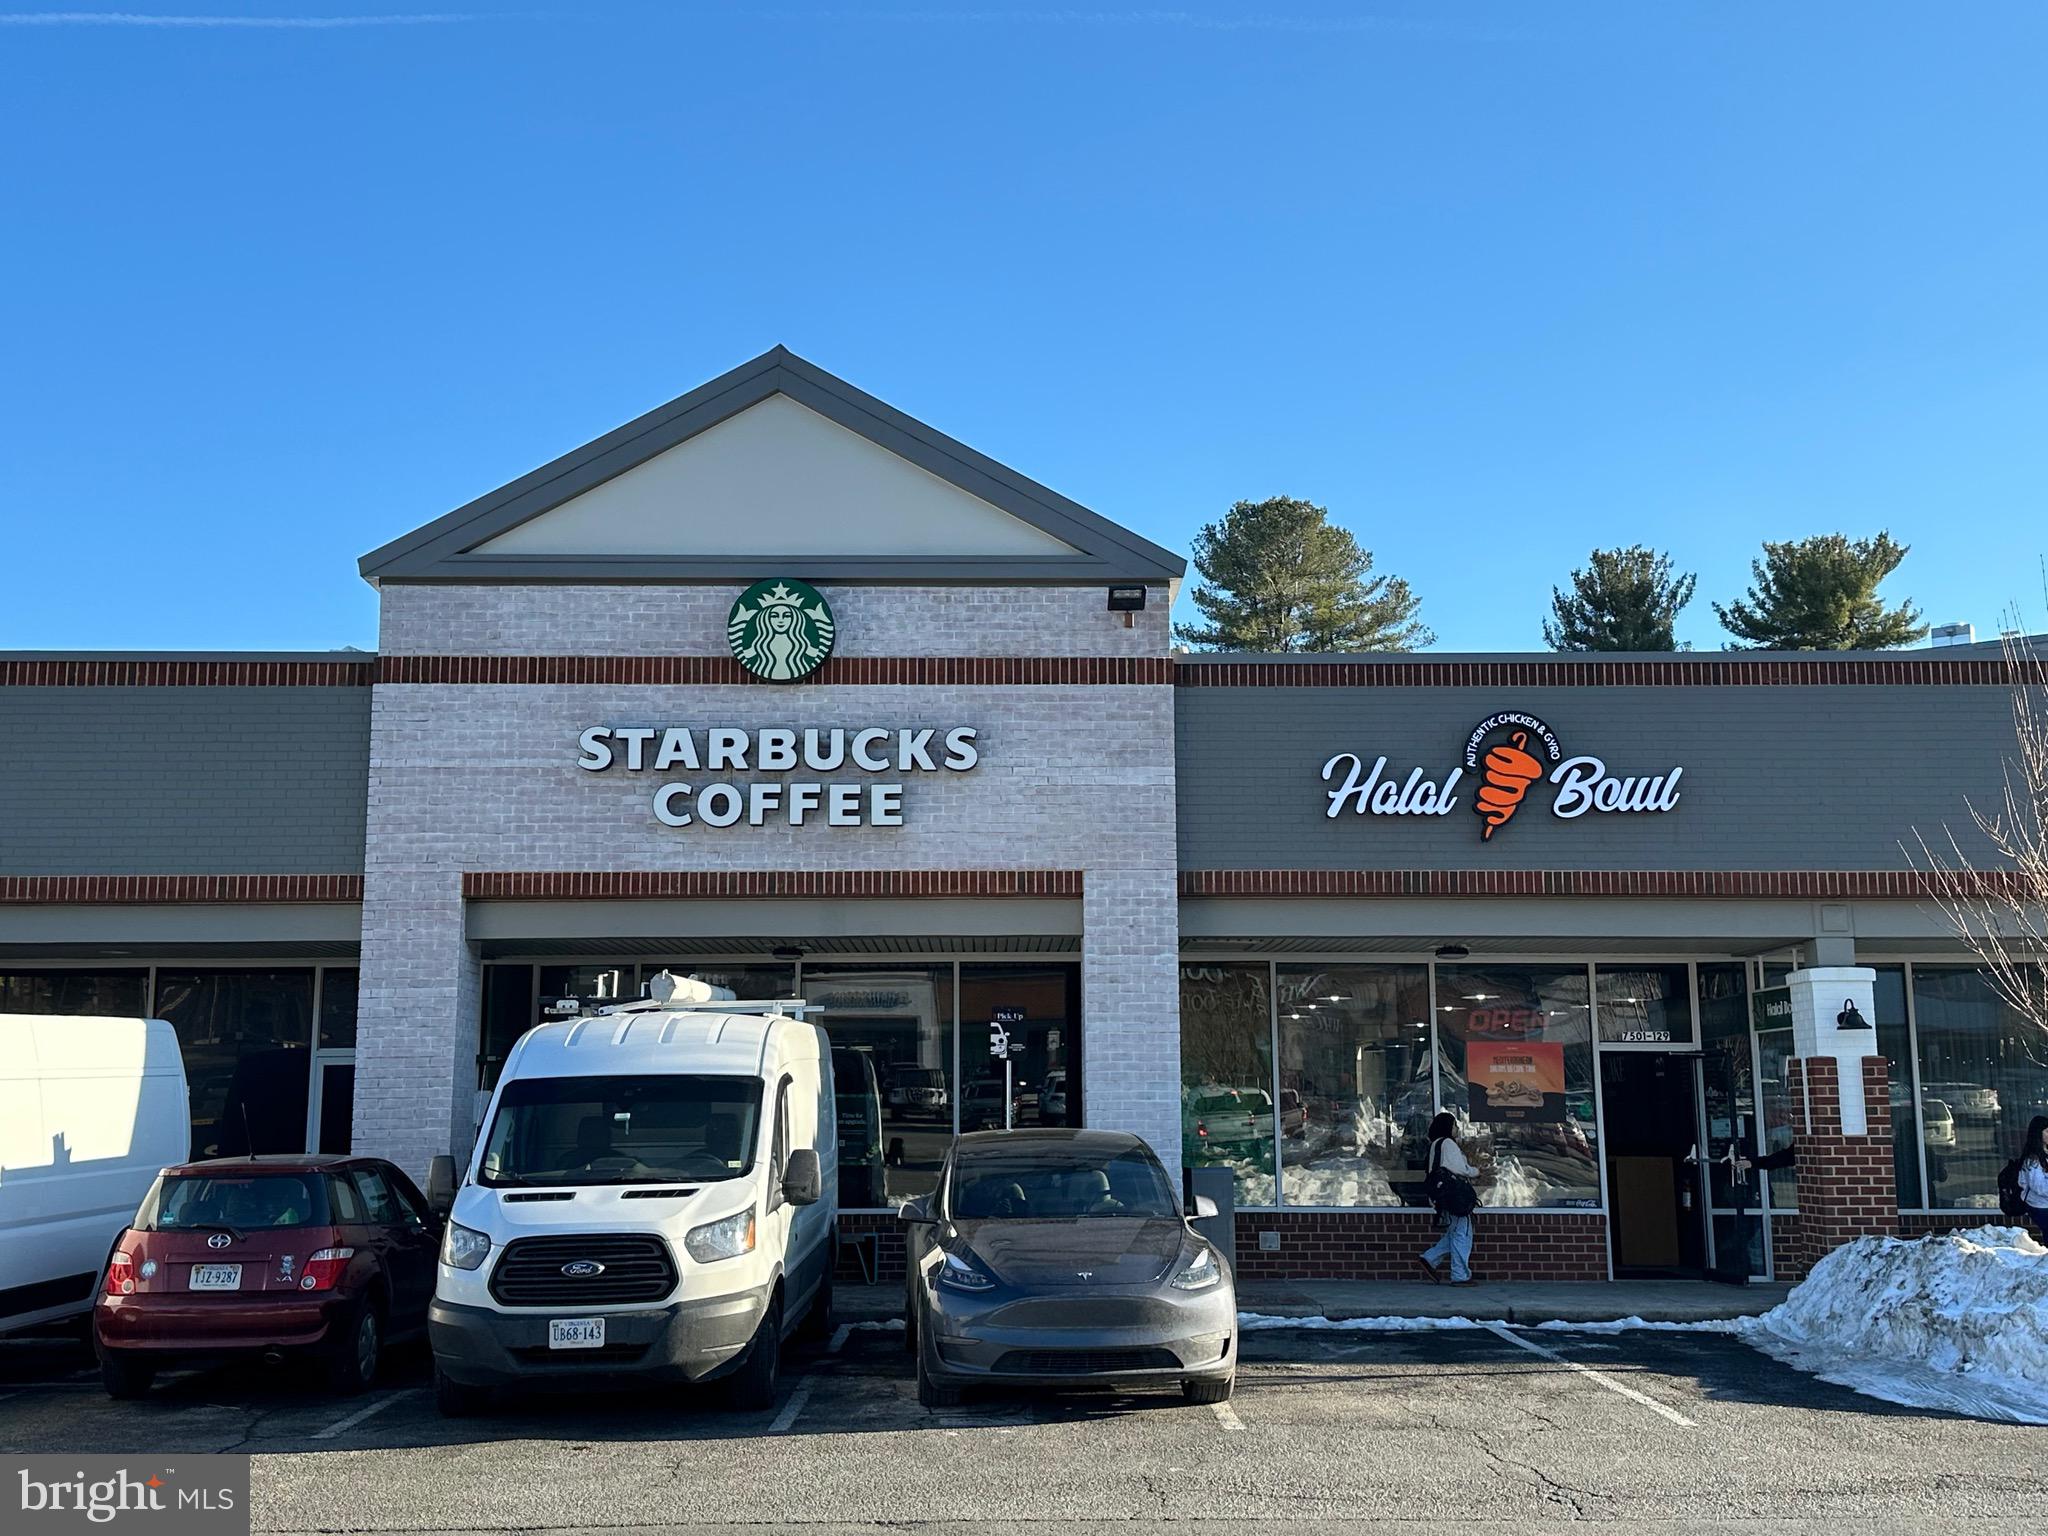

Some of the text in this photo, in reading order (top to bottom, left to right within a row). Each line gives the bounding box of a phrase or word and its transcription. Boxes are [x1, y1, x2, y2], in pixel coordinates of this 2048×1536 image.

[577, 726, 978, 771] STARBUCKS
[1467, 714, 1560, 767] AUTHENTIC CHICKEN & GYRO
[1322, 753, 1683, 818] Halal Bowl
[652, 782, 903, 827] COFFEE
[1469, 1009, 1550, 1031] OPEN
[1622, 1031, 1669, 1041] 7501-129
[194, 1271, 239, 1284] TJZ-9287
[569, 1263, 593, 1274] Ford
[553, 1326, 602, 1341] UB68-143
